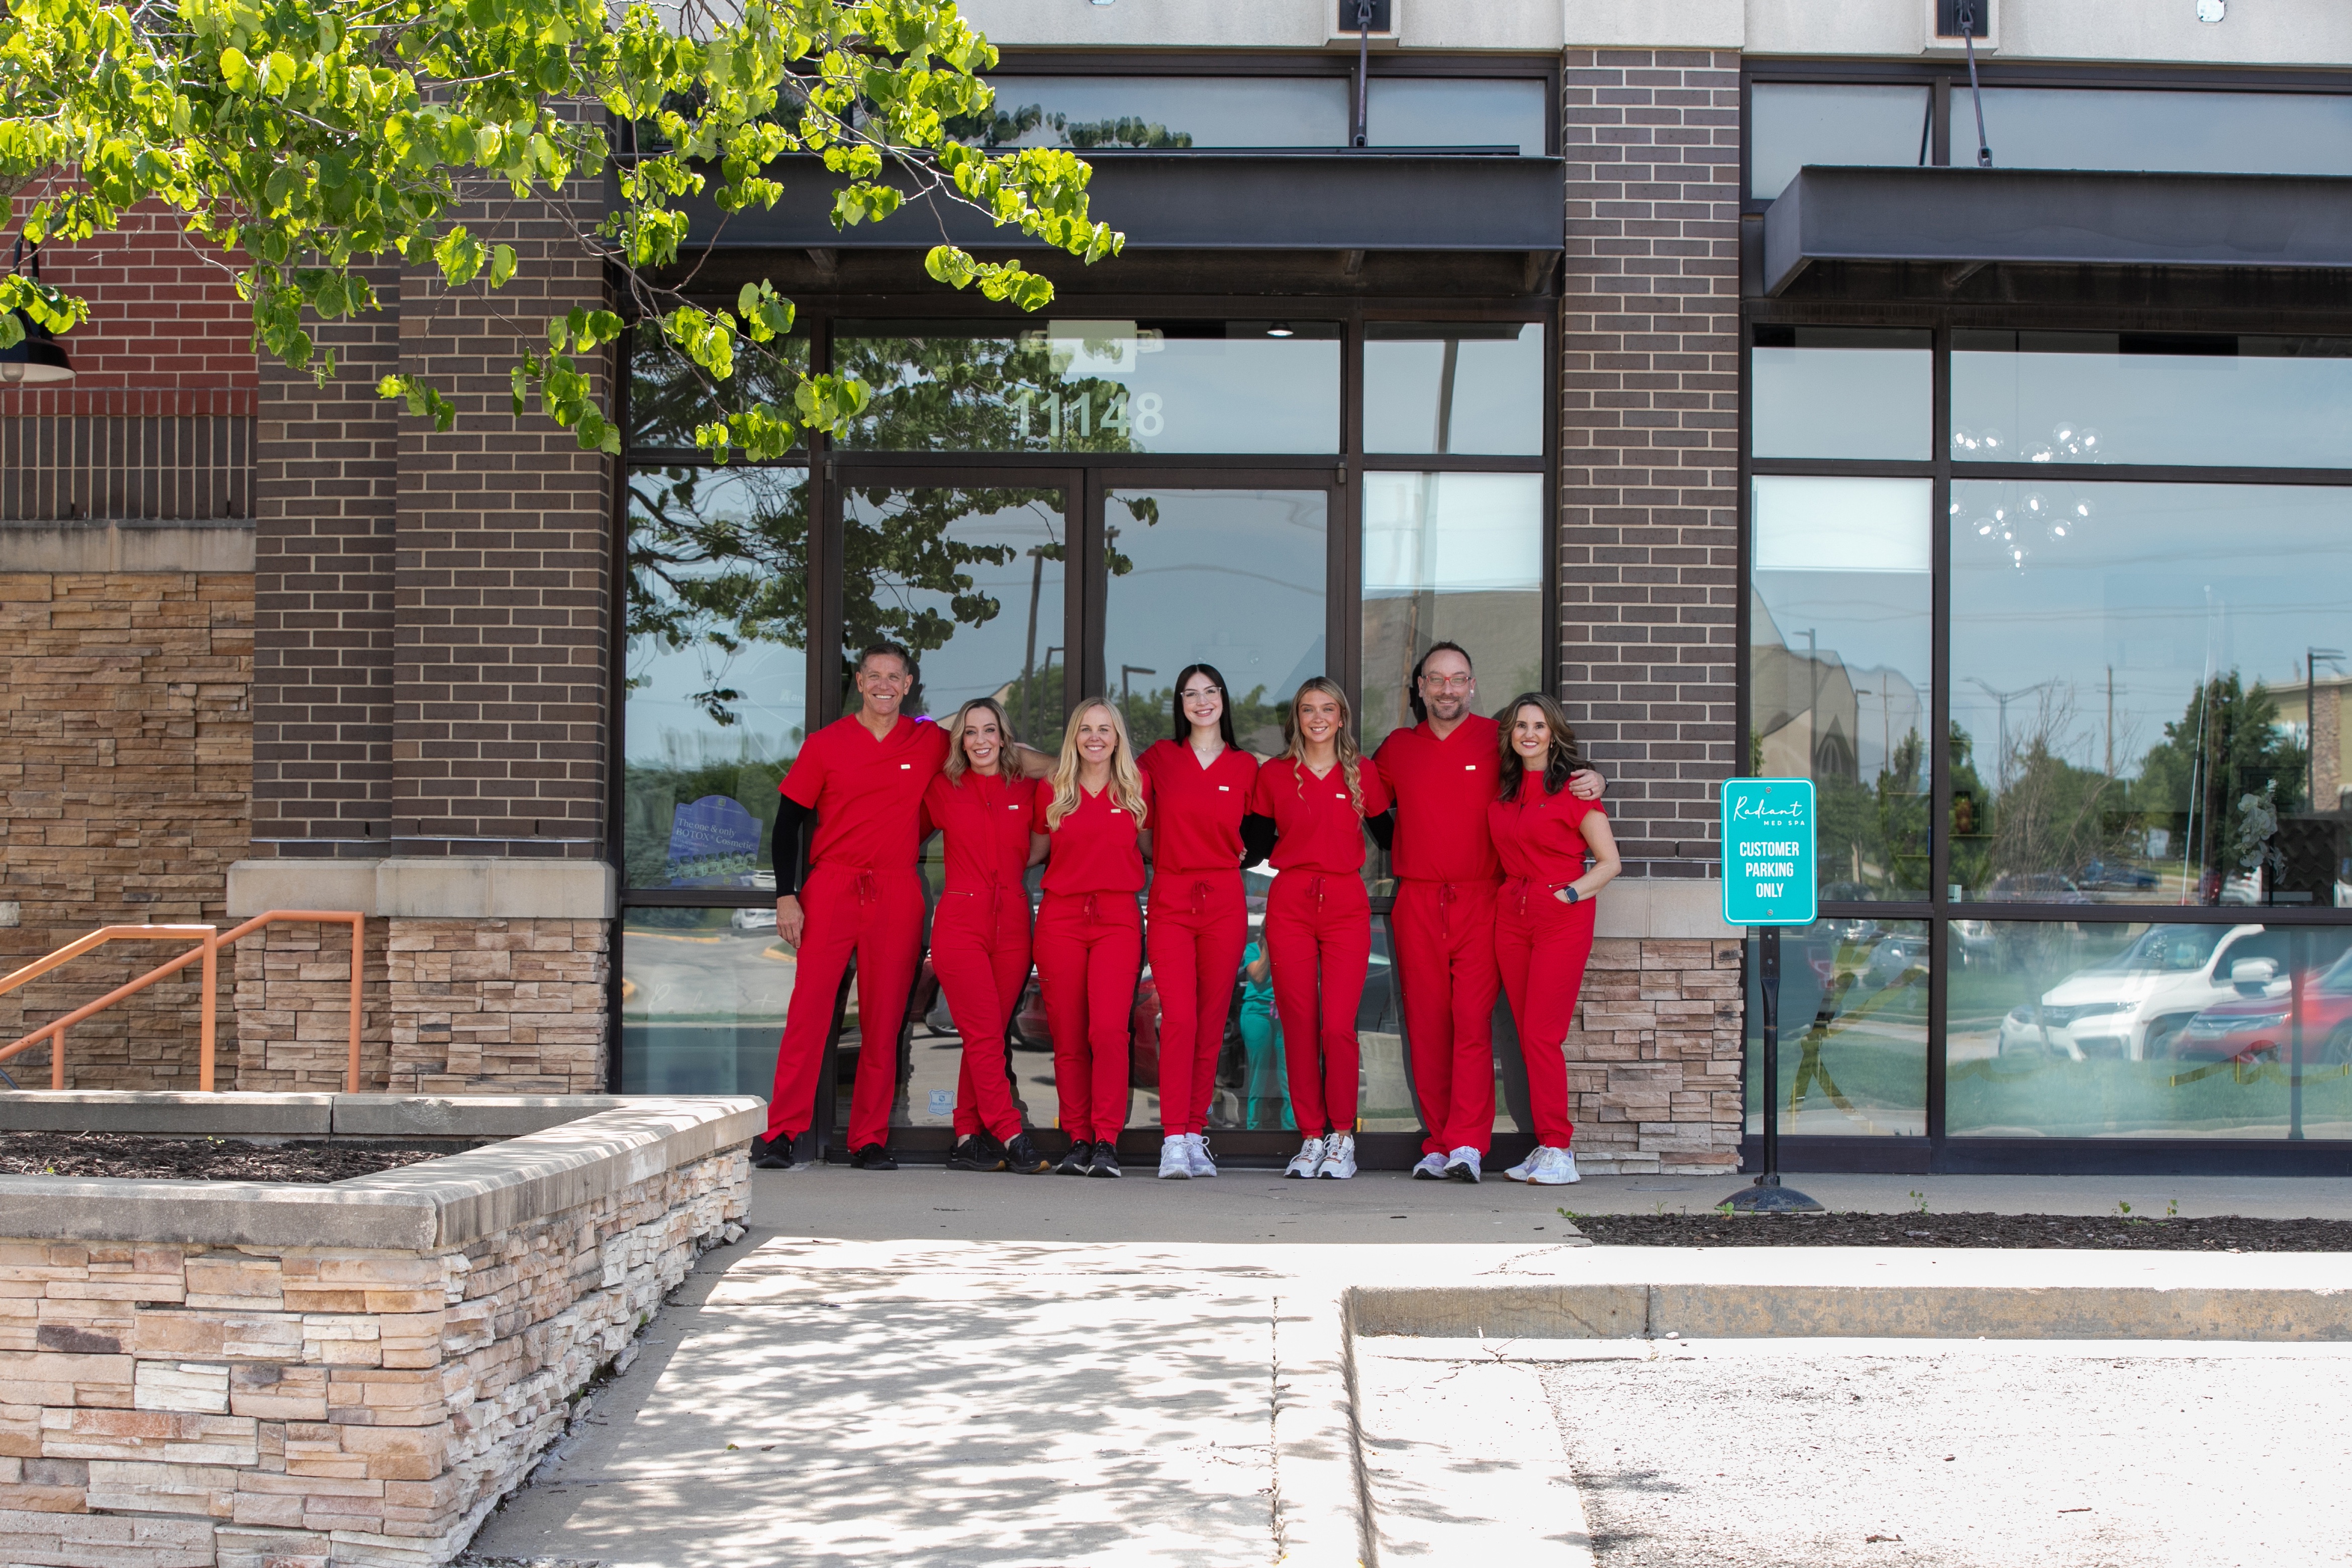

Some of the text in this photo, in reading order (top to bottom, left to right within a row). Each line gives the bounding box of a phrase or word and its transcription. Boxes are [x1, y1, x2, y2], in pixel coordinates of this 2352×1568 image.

[1010, 392, 1164, 436] 11148
[1733, 796, 1803, 821] Radiant
[678, 818, 694, 828] The
[711, 824, 717, 833] &
[719, 828, 736, 838] only
[1739, 841, 1799, 857] CUSTOMER
[1745, 862, 1794, 877] PARKING
[1756, 883, 1784, 898] ONLY
